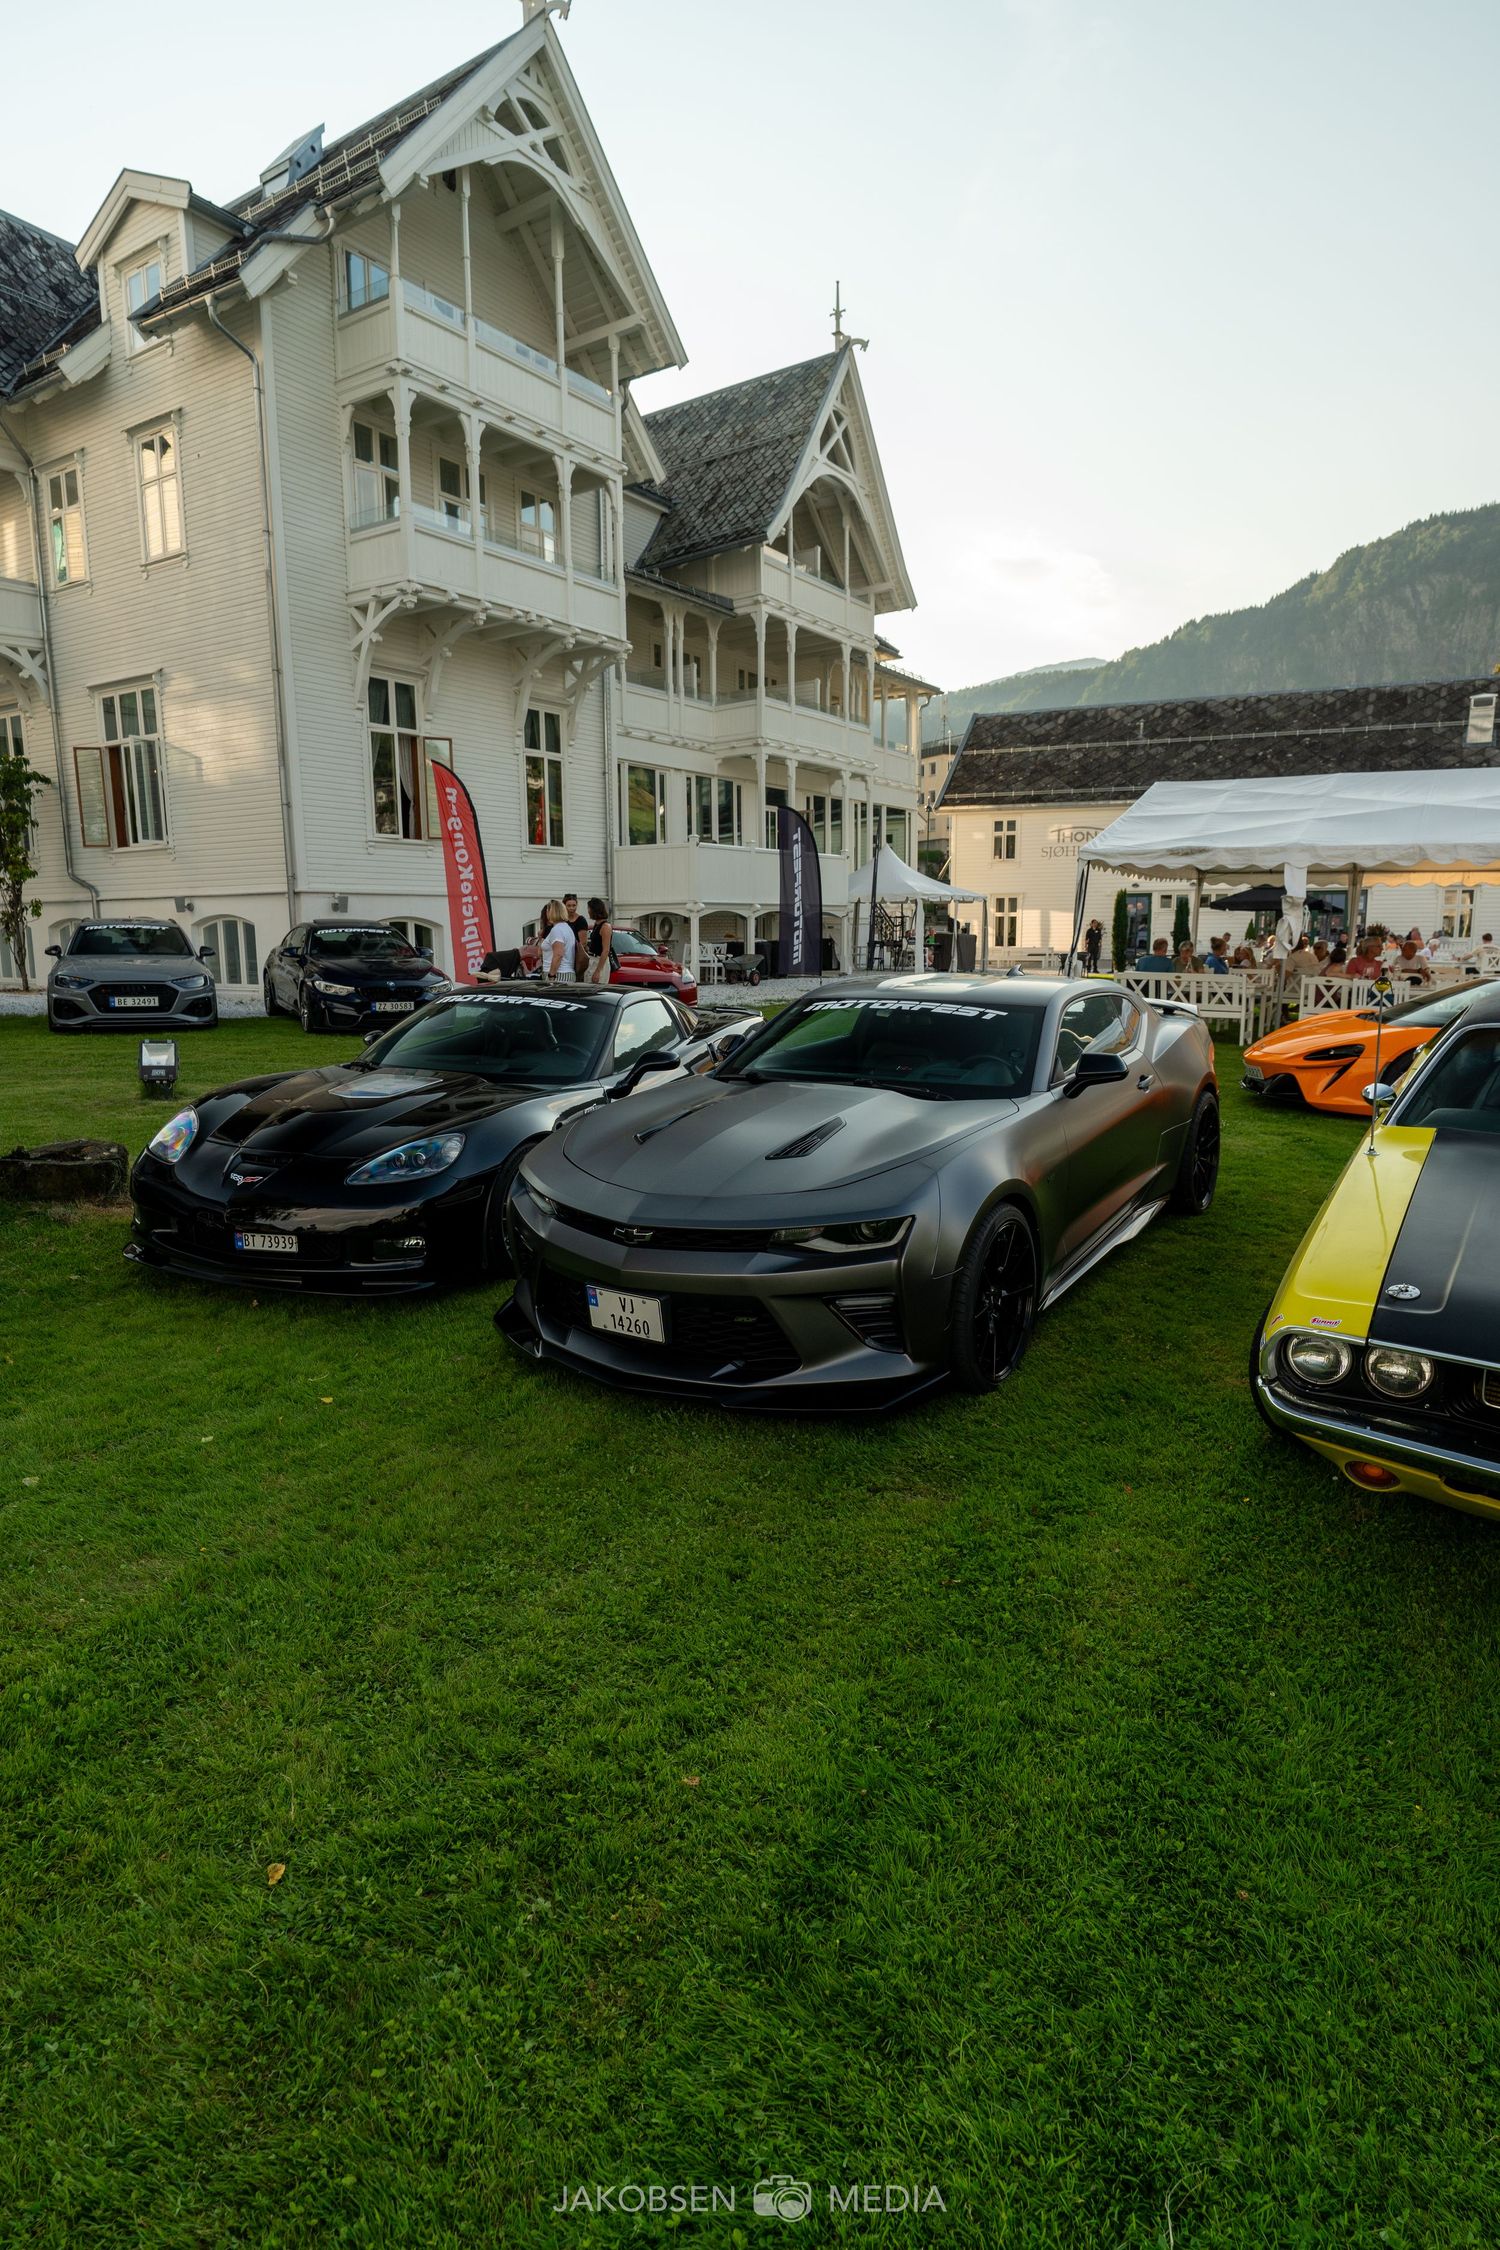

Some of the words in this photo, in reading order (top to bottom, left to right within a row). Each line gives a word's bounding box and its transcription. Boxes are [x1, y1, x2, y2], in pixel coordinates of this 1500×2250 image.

[117, 998, 129, 1006] BE
[132, 997, 157, 1005] 32491
[436, 994, 588, 1011] MOTORFEST
[803, 1000, 1008, 1020] MOTORFEST
[243, 1233, 256, 1247] BT
[260, 1234, 294, 1250] 73939
[618, 1296, 635, 1314] VJ
[610, 1313, 650, 1336] 14260
